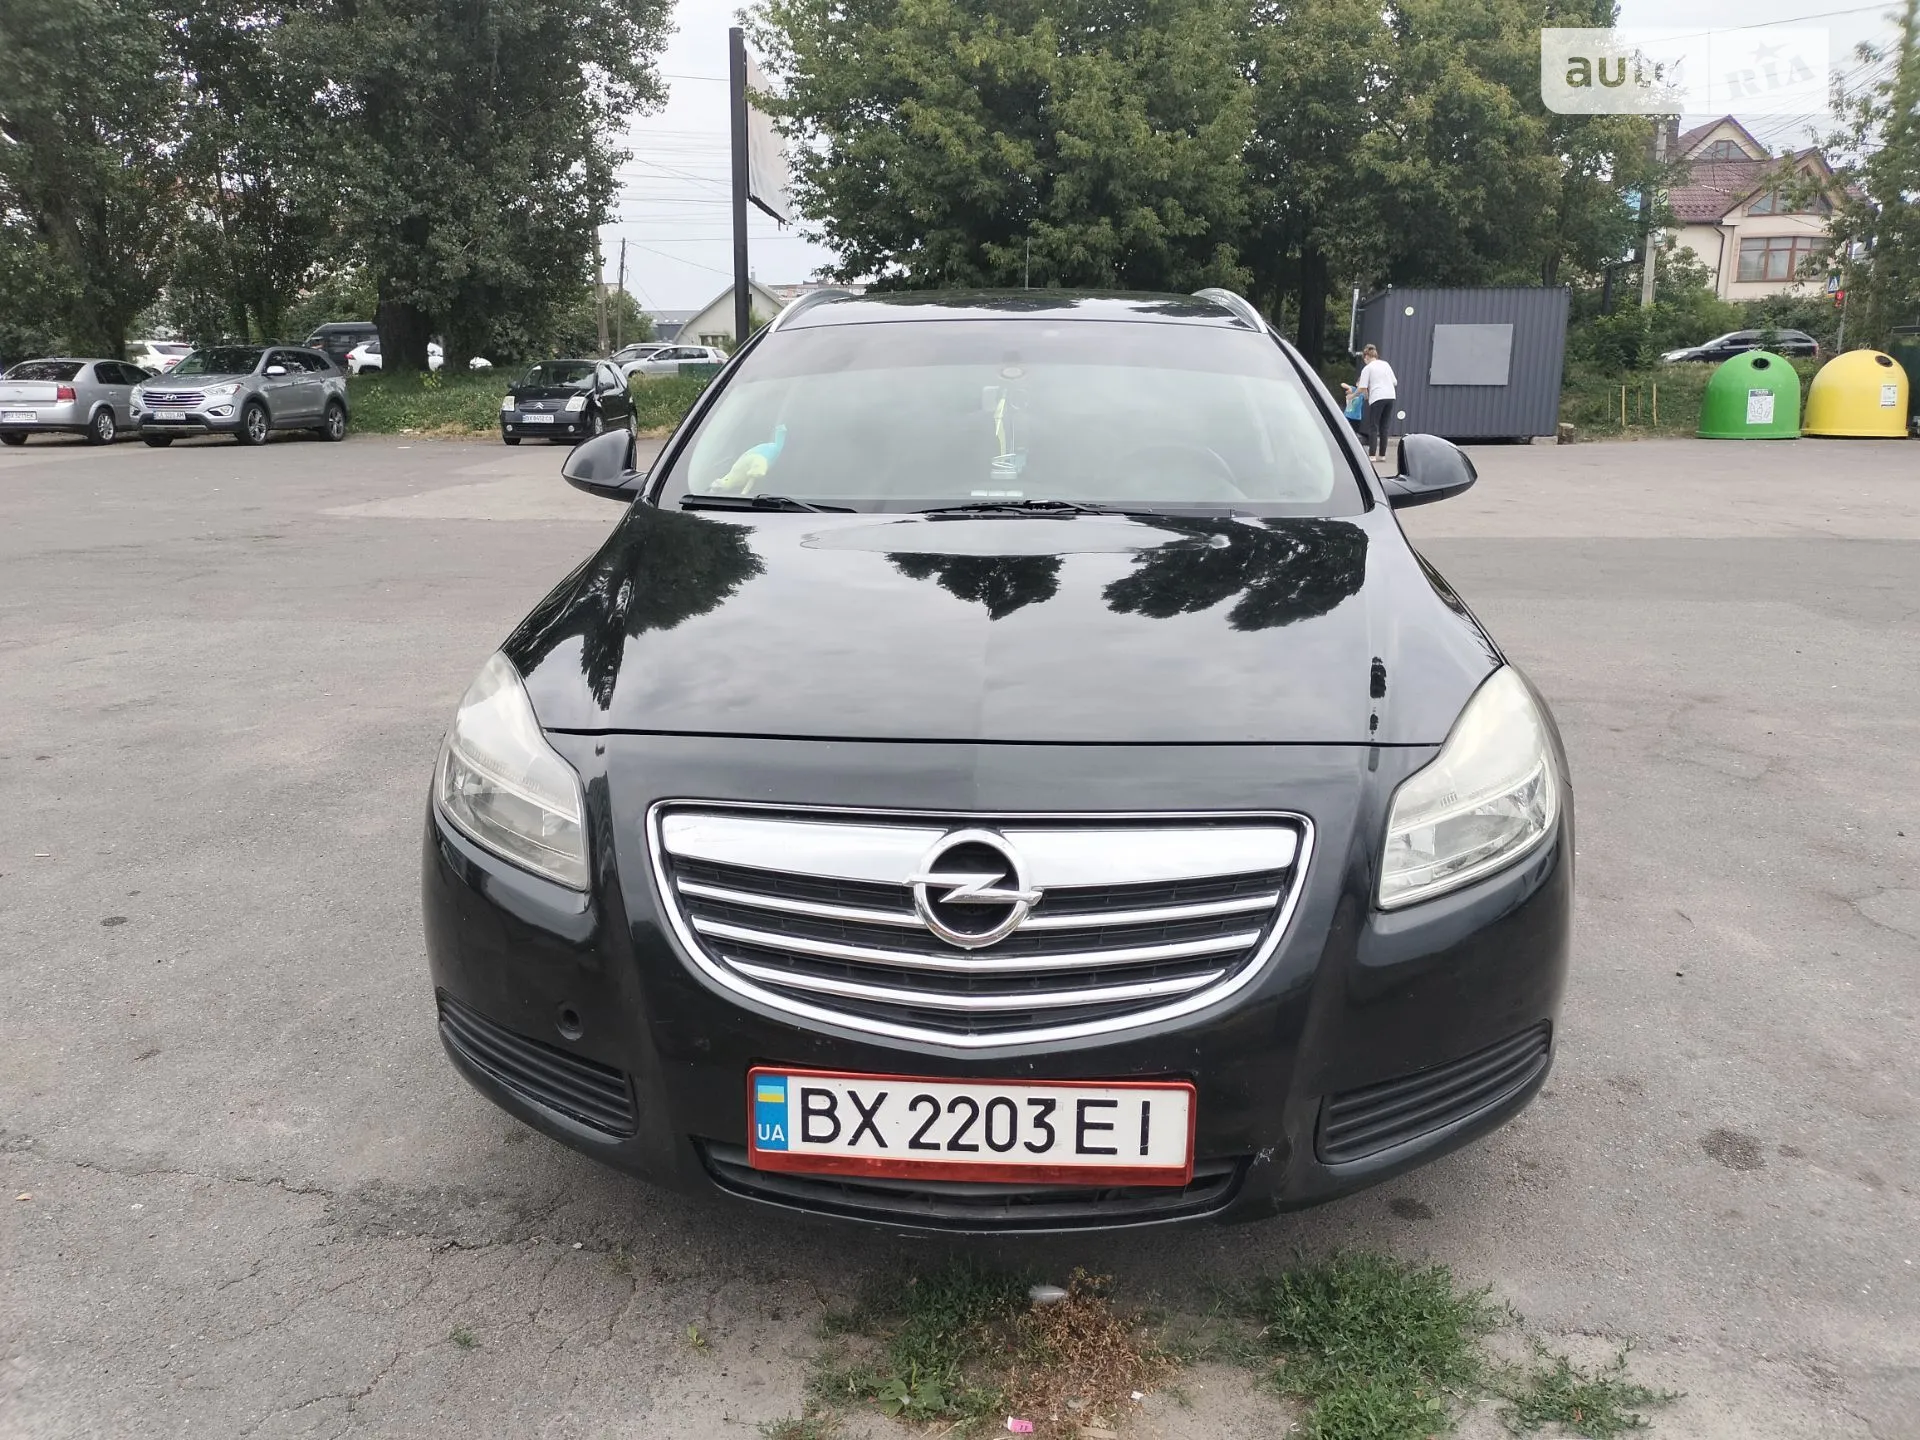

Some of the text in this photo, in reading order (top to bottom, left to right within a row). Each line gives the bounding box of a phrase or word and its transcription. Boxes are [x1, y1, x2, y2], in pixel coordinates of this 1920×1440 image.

[758, 1122, 785, 1142] UA
[801, 1087, 1150, 1156] BX 2203 EI
